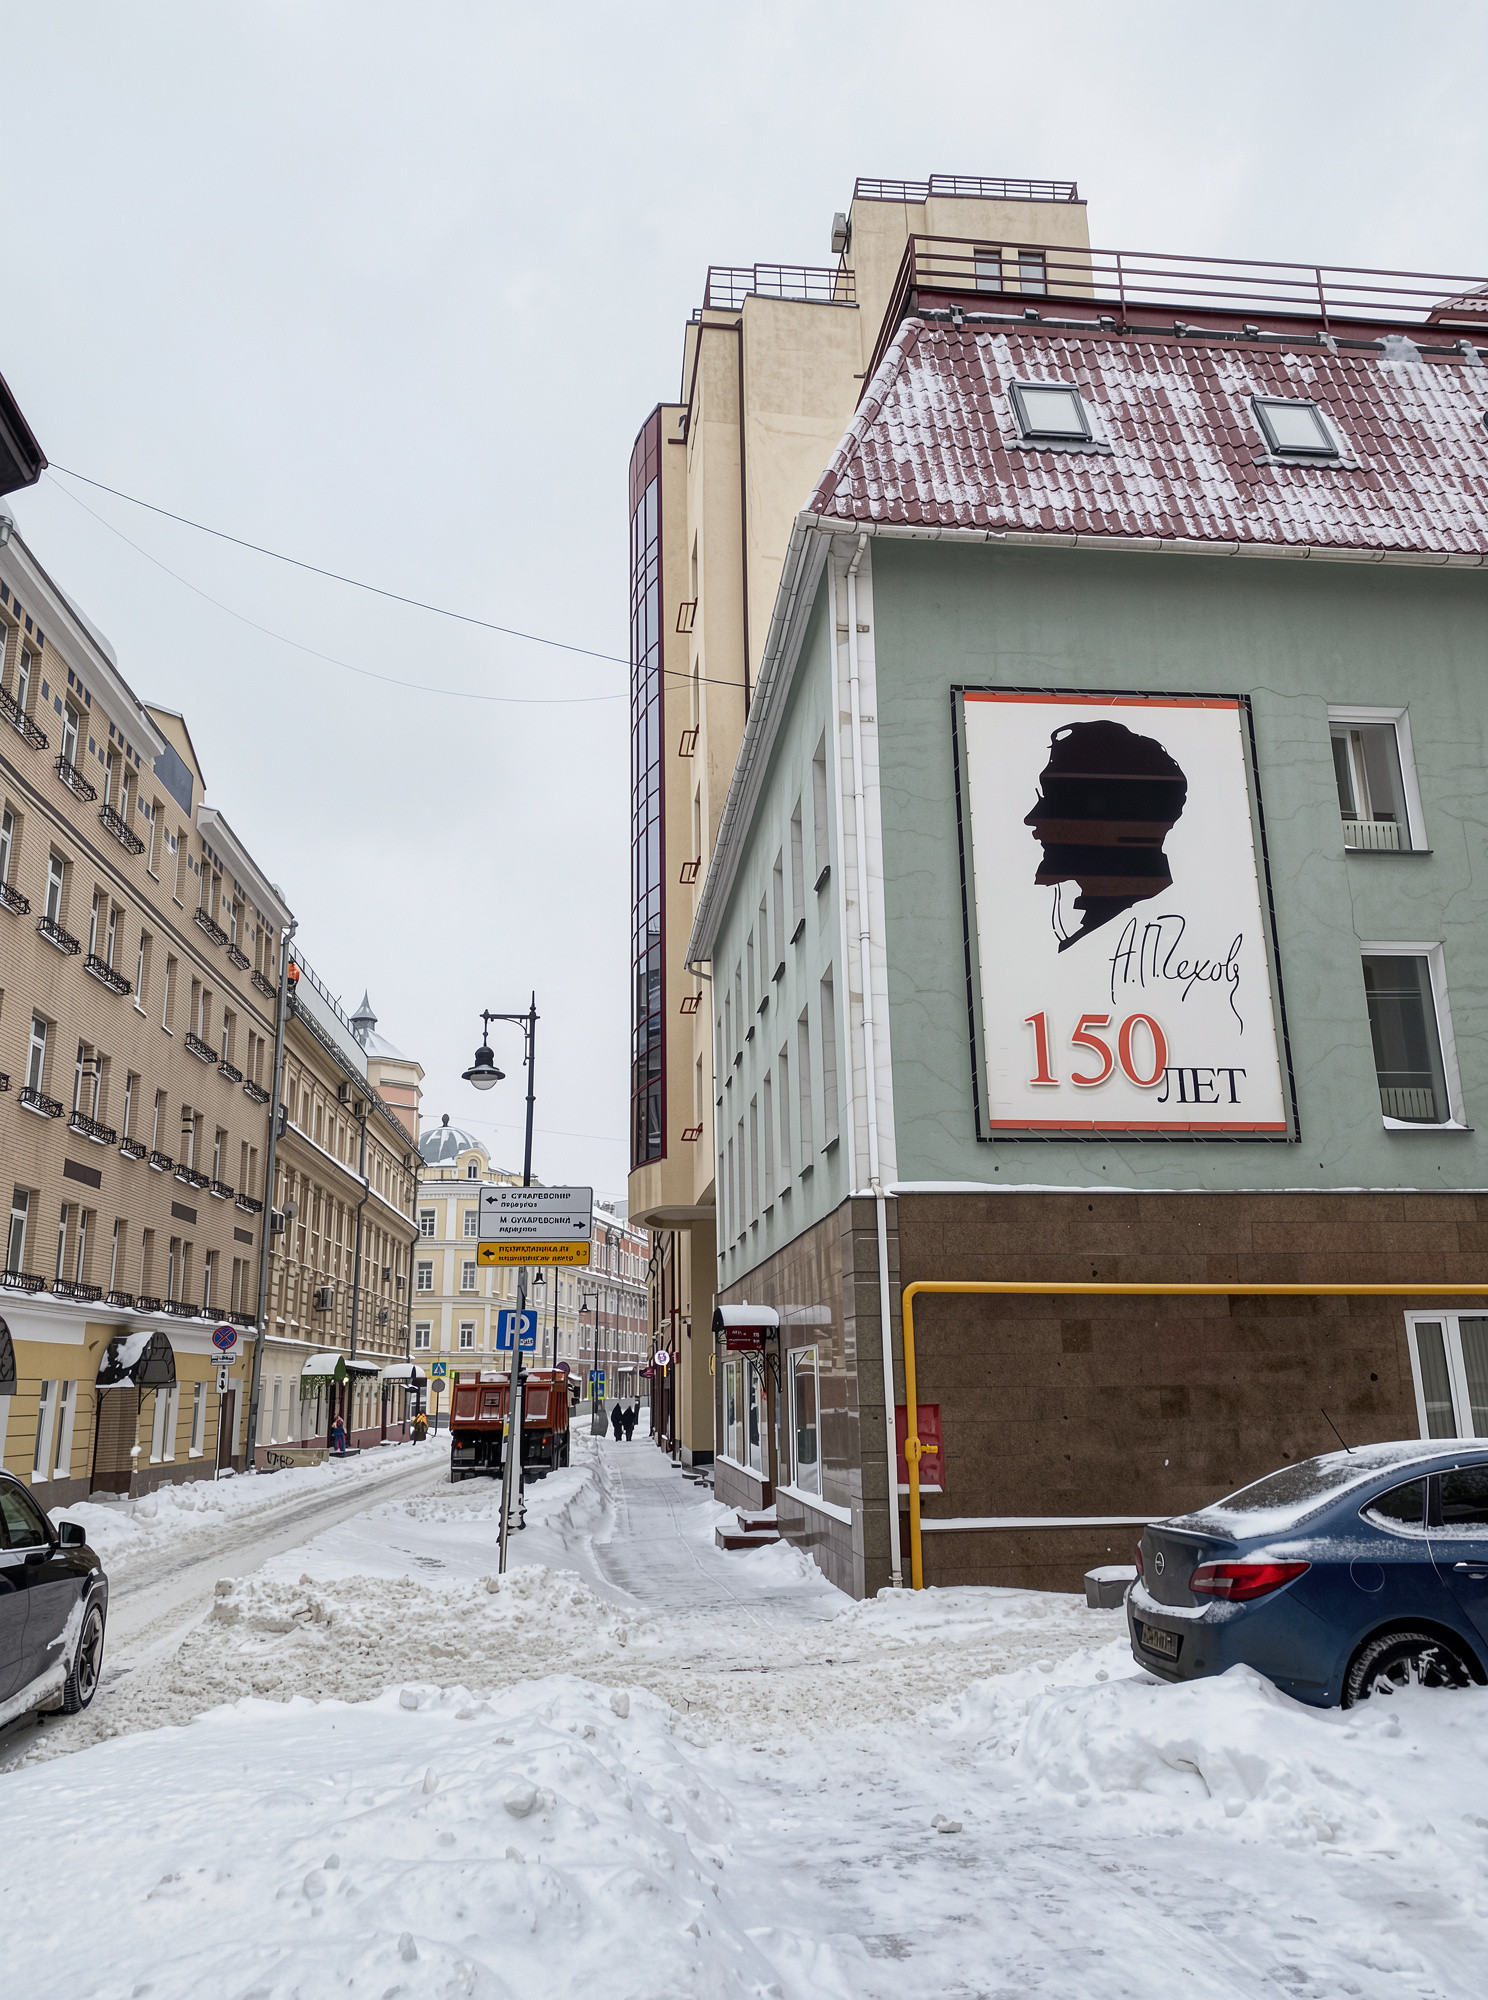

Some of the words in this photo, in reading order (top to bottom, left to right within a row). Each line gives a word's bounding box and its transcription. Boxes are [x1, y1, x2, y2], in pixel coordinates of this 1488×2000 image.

[1024, 1011, 1169, 1088] 150
[1157, 1066, 1247, 1104] ЛЕТ
[505, 1313, 530, 1347] P
